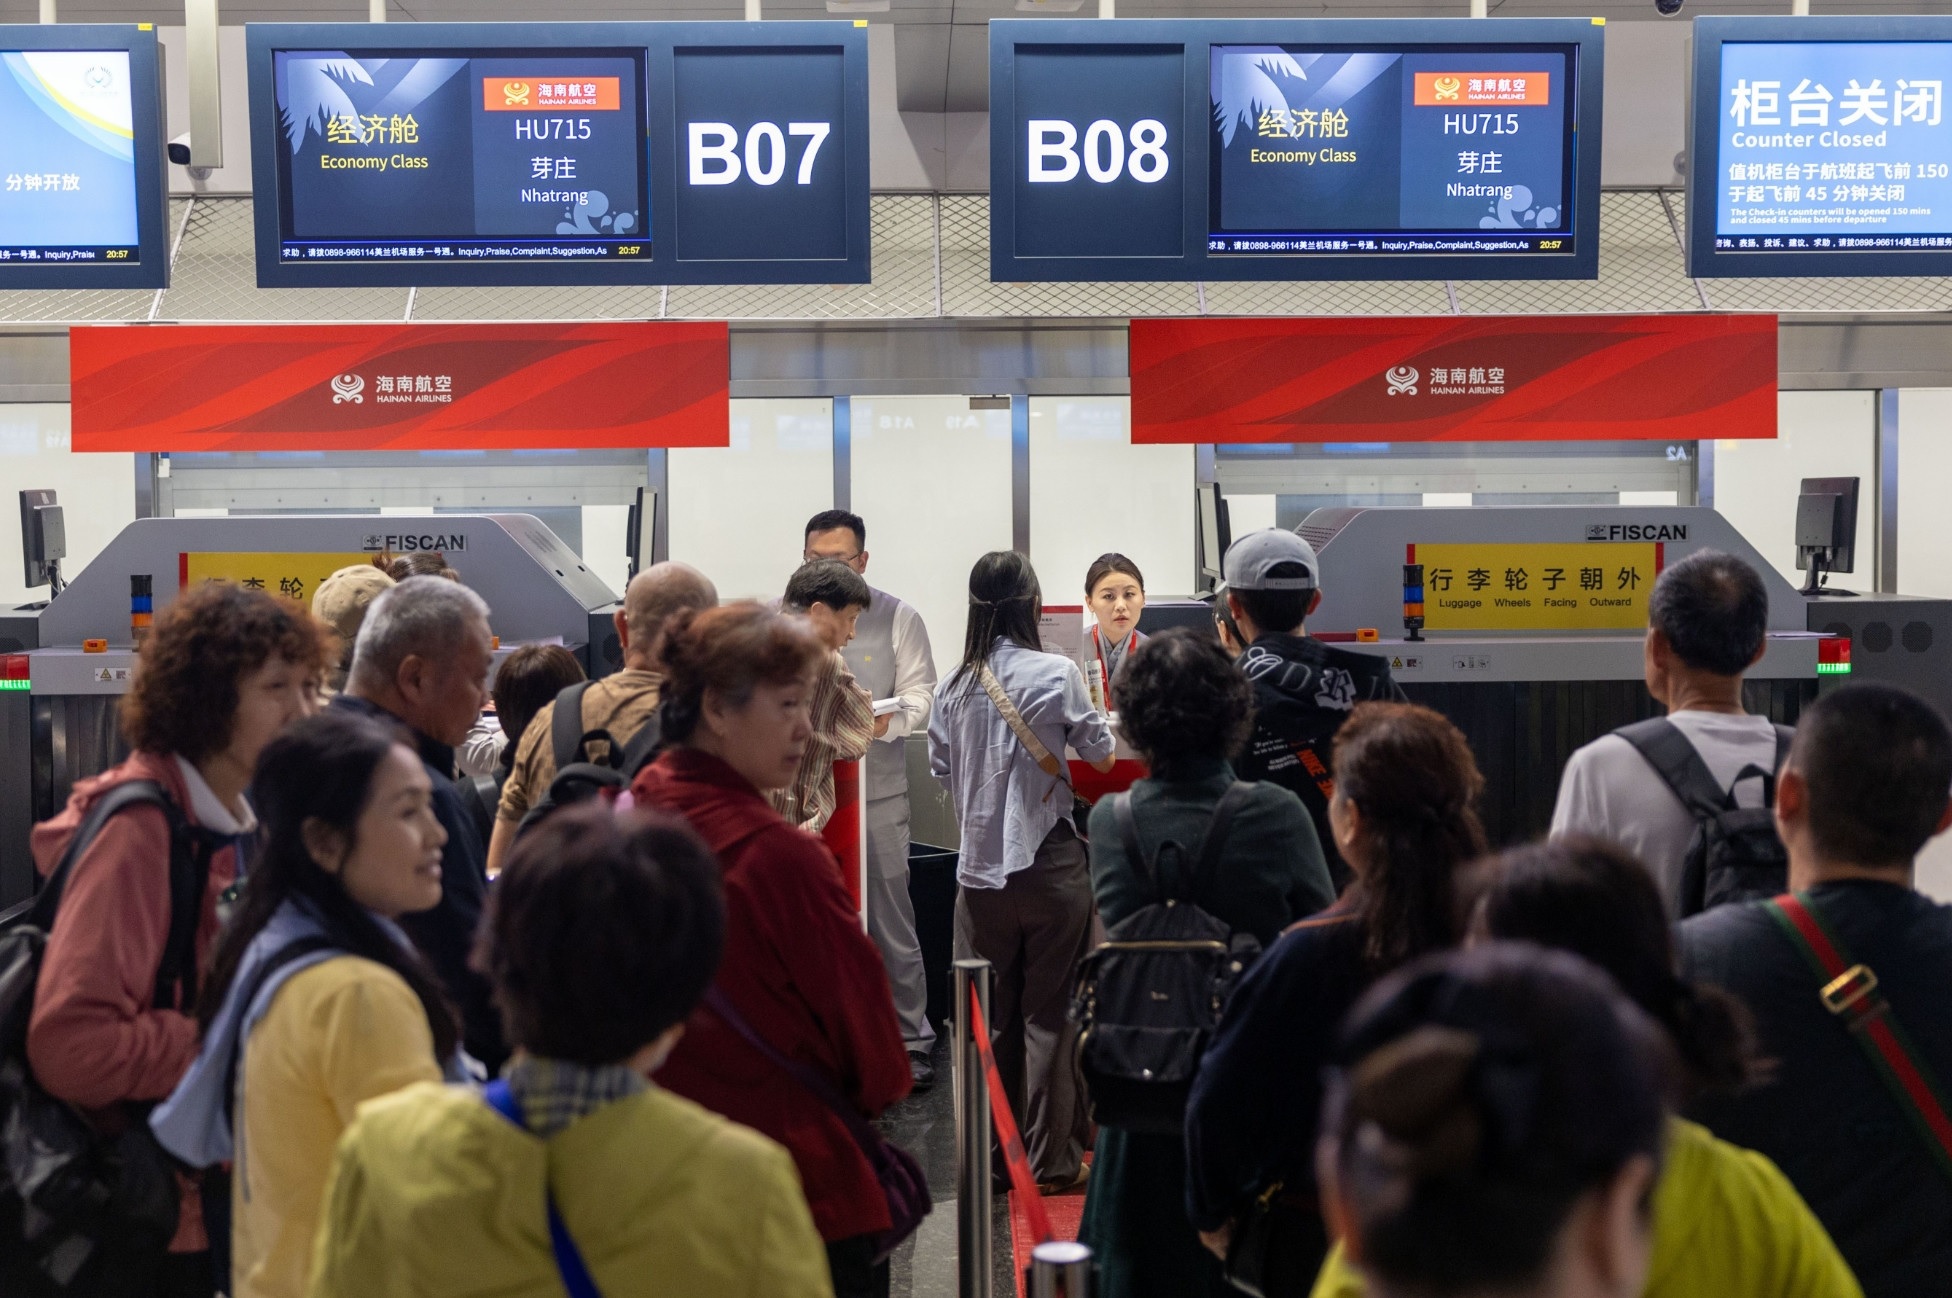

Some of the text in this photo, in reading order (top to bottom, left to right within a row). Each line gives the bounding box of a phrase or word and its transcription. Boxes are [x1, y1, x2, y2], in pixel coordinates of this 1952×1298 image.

[538, 84, 596, 97] 海南航空
[1468, 79, 1526, 92] 海南航空
[1730, 78, 1942, 127] 柜台关闭
[327, 114, 419, 144] 经济舱
[516, 118, 592, 140] HU715
[1258, 108, 1349, 138] 经济舱
[1444, 114, 1519, 134] HU715
[1732, 131, 1887, 148] Counter Closed
[687, 122, 831, 186] B07
[1028, 119, 1170, 184] B08
[1250, 148, 1357, 166] Economy Class
[321, 154, 429, 172] Economy Class
[531, 157, 577, 180] 芽庄
[1458, 151, 1503, 174] 芽庄
[1728, 163, 1949, 180] 值机柜台于航班起飞前 150
[6, 174, 81, 192] 分钟开放
[1447, 182, 1513, 200] Nhatrang
[522, 188, 589, 206] Nhatrang
[1728, 184, 1905, 202] 于起飞前 45 分钟关闭
[1730, 208, 1747, 216] The
[1749, 208, 1786, 216] Check-in
[1788, 208, 1829, 216] counters
[1858, 208, 1891, 216] opened
[1730, 216, 1887, 224] and closed 45 mins before departure
[618, 246, 640, 254] 20:57
[1540, 240, 1562, 249] 20:57
[106, 250, 128, 258] 20:57
[376, 376, 452, 393] 海南航空
[1430, 367, 1504, 385] 海南航空
[376, 394, 452, 403] HAINAN AIRLINES
[1430, 386, 1504, 394] HAINAN AIRLINES
[1609, 525, 1687, 540] FISCAN
[385, 534, 464, 550] FISCAN
[1430, 568, 1641, 591] 行李轮子朝外
[1439, 598, 1632, 608] Luggage Wheels Facing Outward
